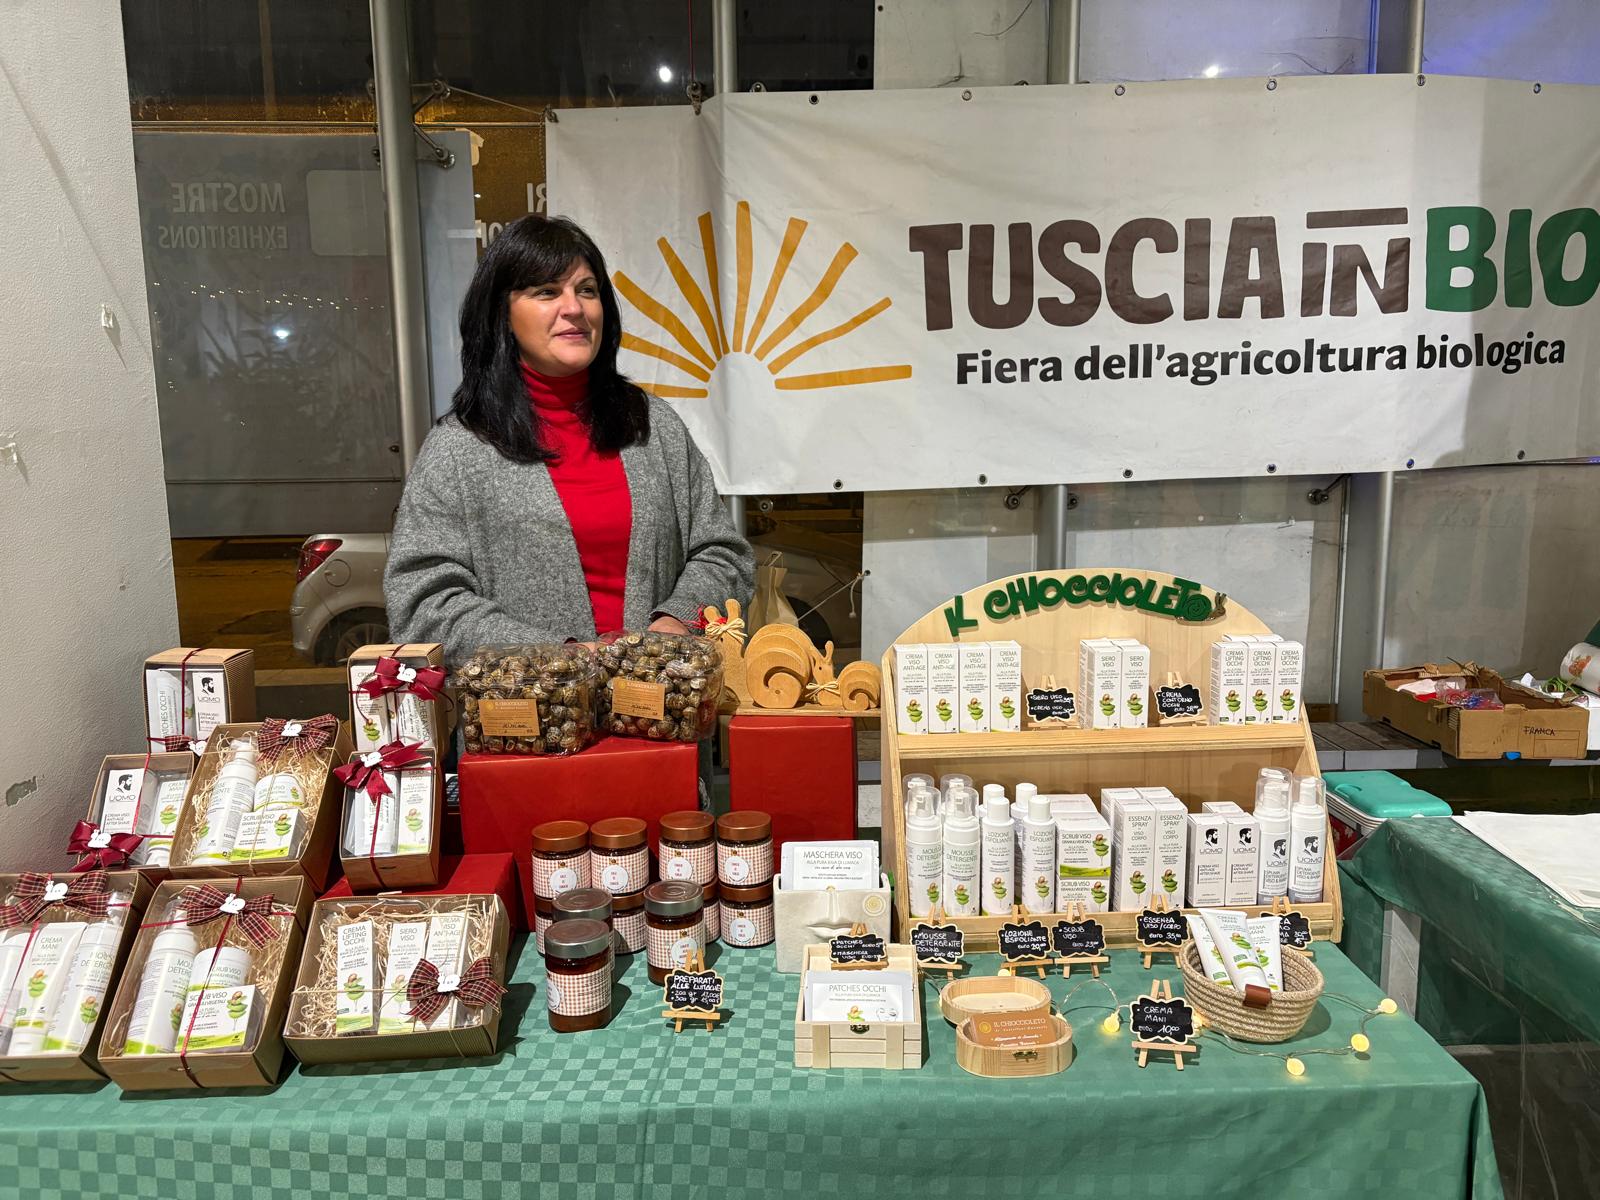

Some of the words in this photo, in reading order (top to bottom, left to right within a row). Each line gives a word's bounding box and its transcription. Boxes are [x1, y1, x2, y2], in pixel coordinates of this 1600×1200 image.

[909, 216, 1285, 330] TUSCIA
[1301, 237, 1410, 316] IN
[1425, 206, 1600, 312] BIO
[957, 351, 1062, 384] Fiera
[1416, 331, 1565, 375] biologica
[944, 596, 978, 637] IL
[160, 710, 169, 737] ATCHES
[1524, 726, 1556, 736] FRANCA
[343, 925, 366, 934] CREMA
[342, 931, 367, 941] LIFTING
[344, 938, 366, 946] OCCHI
[674, 975, 714, 984] PREPARATI
[189, 992, 212, 1002] SCUB
